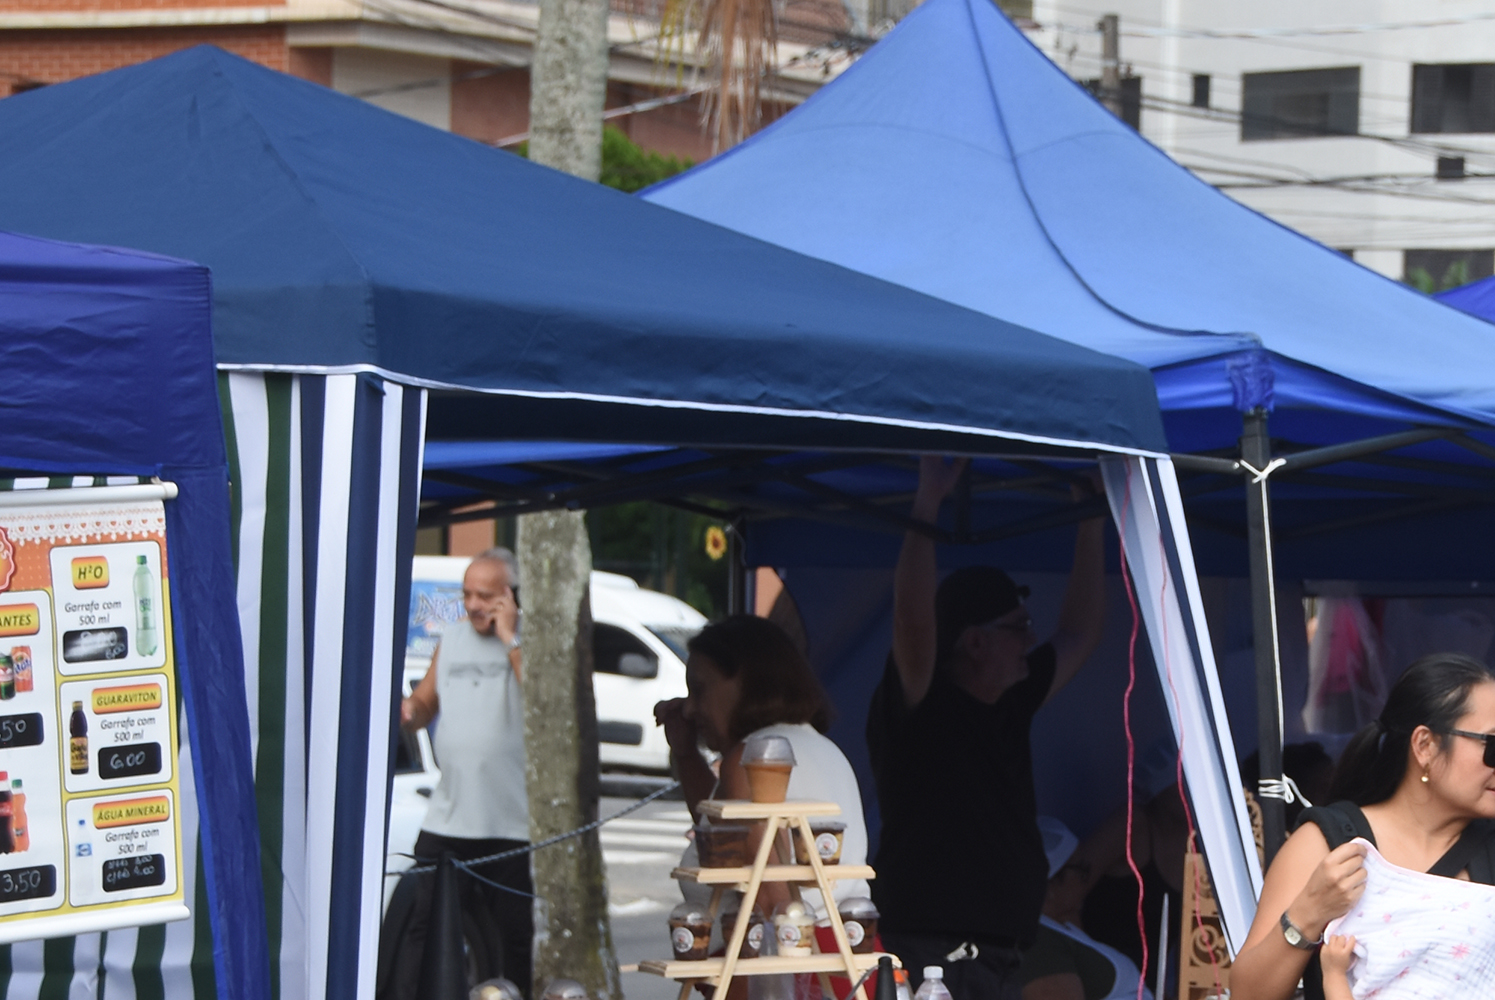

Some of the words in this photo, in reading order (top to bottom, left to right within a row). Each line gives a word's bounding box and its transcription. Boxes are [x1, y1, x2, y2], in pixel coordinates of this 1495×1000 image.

[102, 601, 122, 610] com
[79, 615, 96, 626] 500
[98, 613, 110, 624] ml
[97, 691, 157, 707] GUARAVITON
[137, 716, 156, 727] com
[114, 731, 130, 743] 500
[132, 730, 144, 740] ml
[125, 804, 166, 818] MINERAL
[141, 828, 160, 838] com
[118, 844, 134, 856] 500
[136, 841, 148, 852] ml
